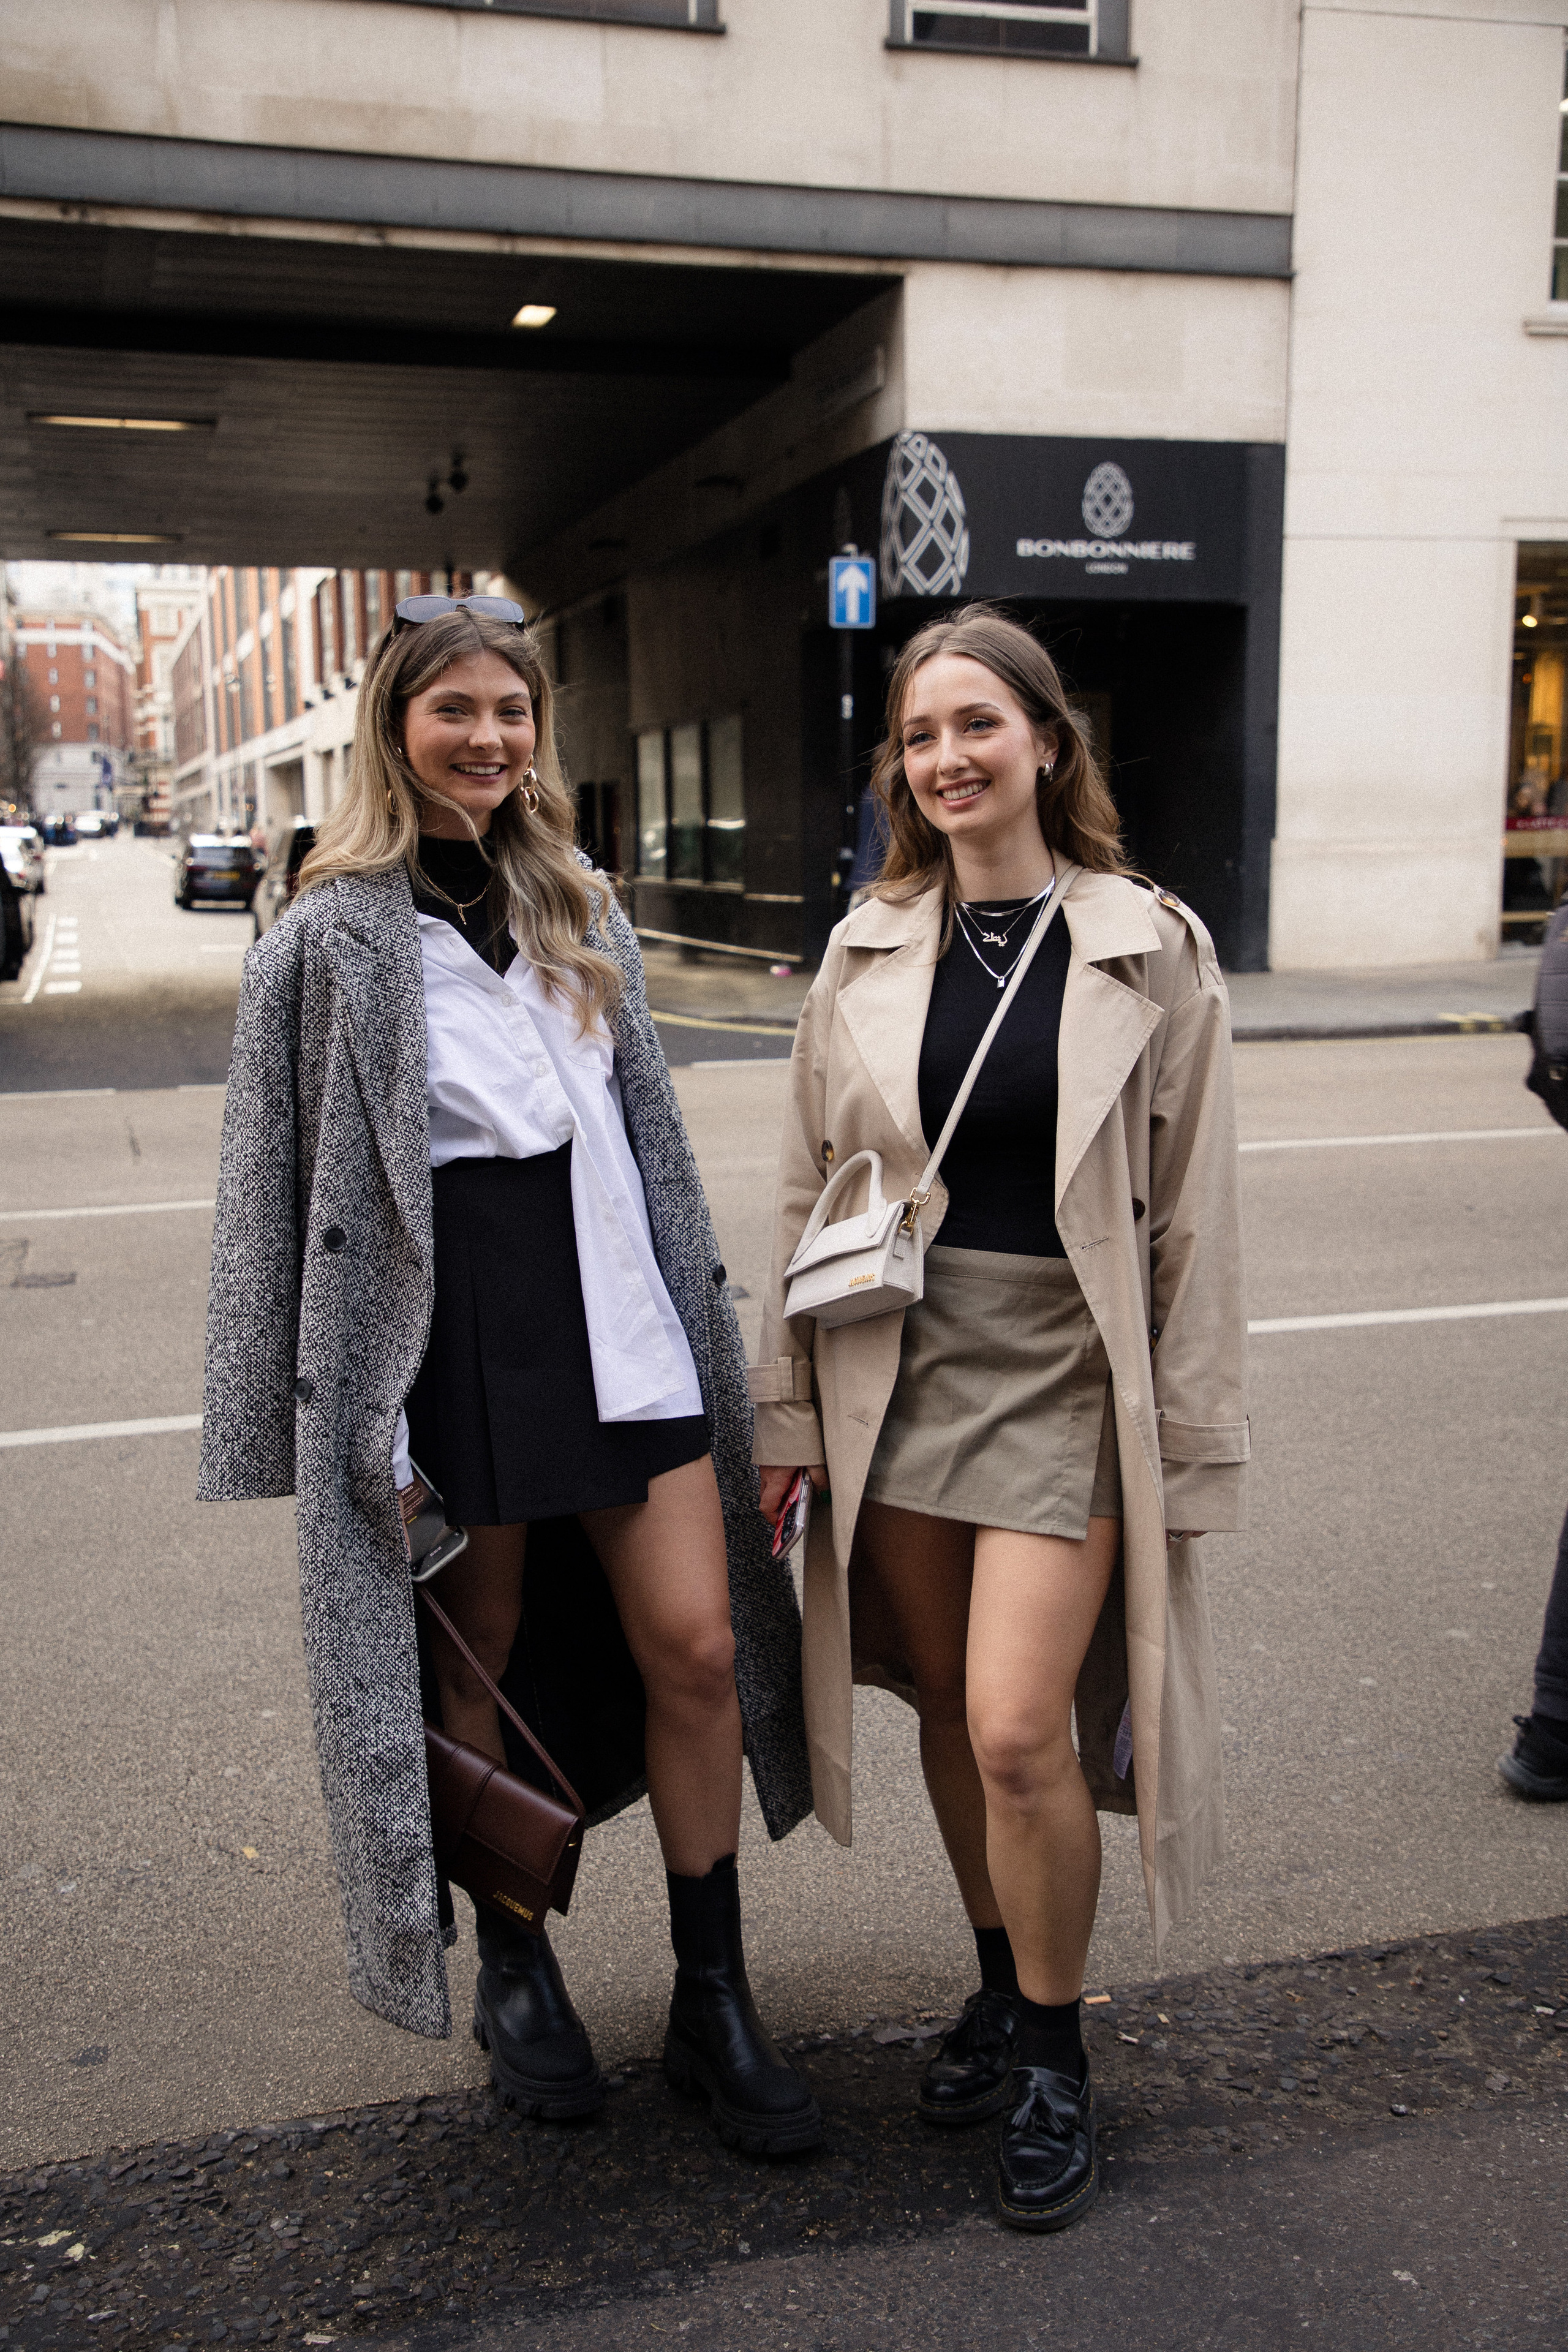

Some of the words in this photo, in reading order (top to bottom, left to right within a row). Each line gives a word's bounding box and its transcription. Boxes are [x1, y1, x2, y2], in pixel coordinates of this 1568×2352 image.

[1016, 538, 1196, 560] BONBONNIERE
[401, 1485, 413, 1496] Video
[492, 1890, 534, 1921] JACQUEMUS
